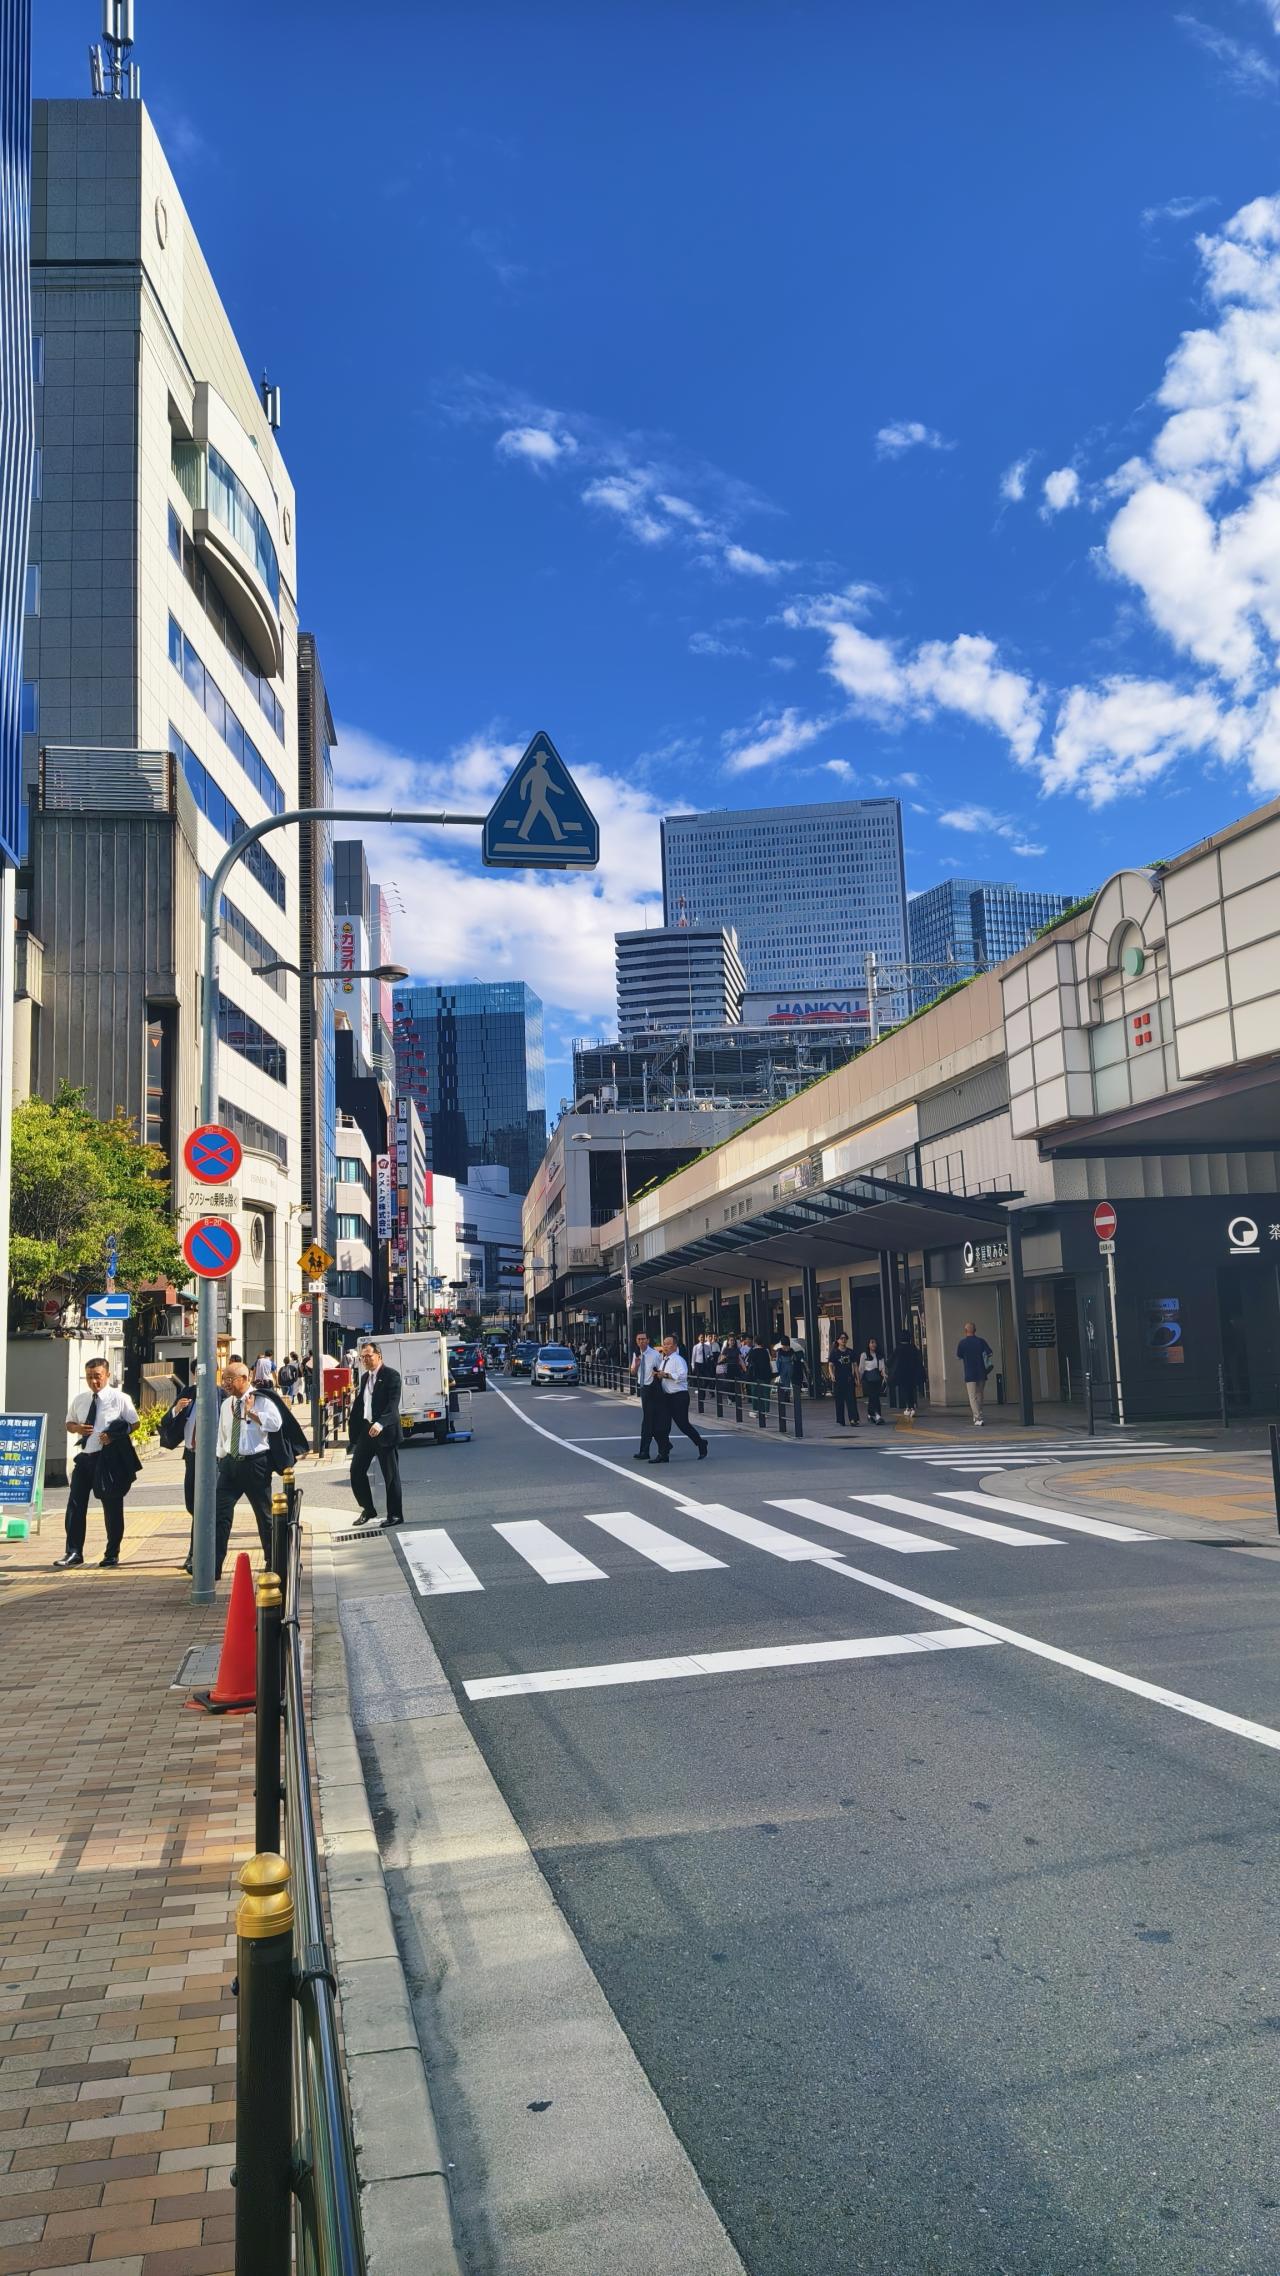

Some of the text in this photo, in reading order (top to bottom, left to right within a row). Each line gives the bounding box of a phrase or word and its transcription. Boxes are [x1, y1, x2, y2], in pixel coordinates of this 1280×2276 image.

[776, 1001, 860, 1015] HANKYU
[189, 1192, 238, 1208] タクシーの乗降を除く
[378, 1172, 387, 1235] ウメトク株式会社
[93, 1326, 121, 1334] ここから
